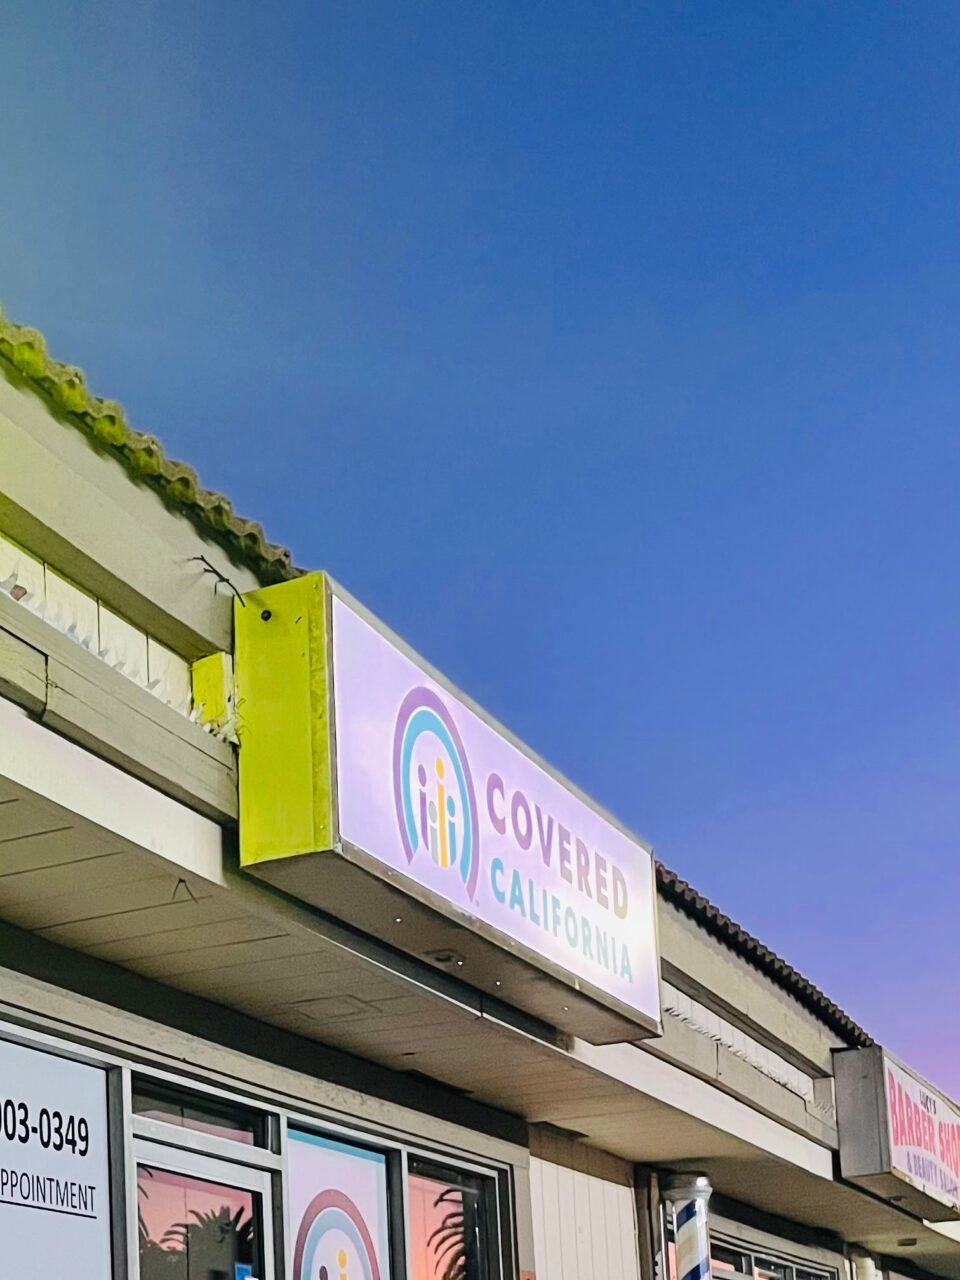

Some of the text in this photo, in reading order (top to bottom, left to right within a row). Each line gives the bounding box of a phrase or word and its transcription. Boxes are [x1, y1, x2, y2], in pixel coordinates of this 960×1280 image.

[487, 773, 628, 919] COVERED
[491, 857, 634, 984] CALIFORNIA
[888, 1068, 936, 1155] BARBER
